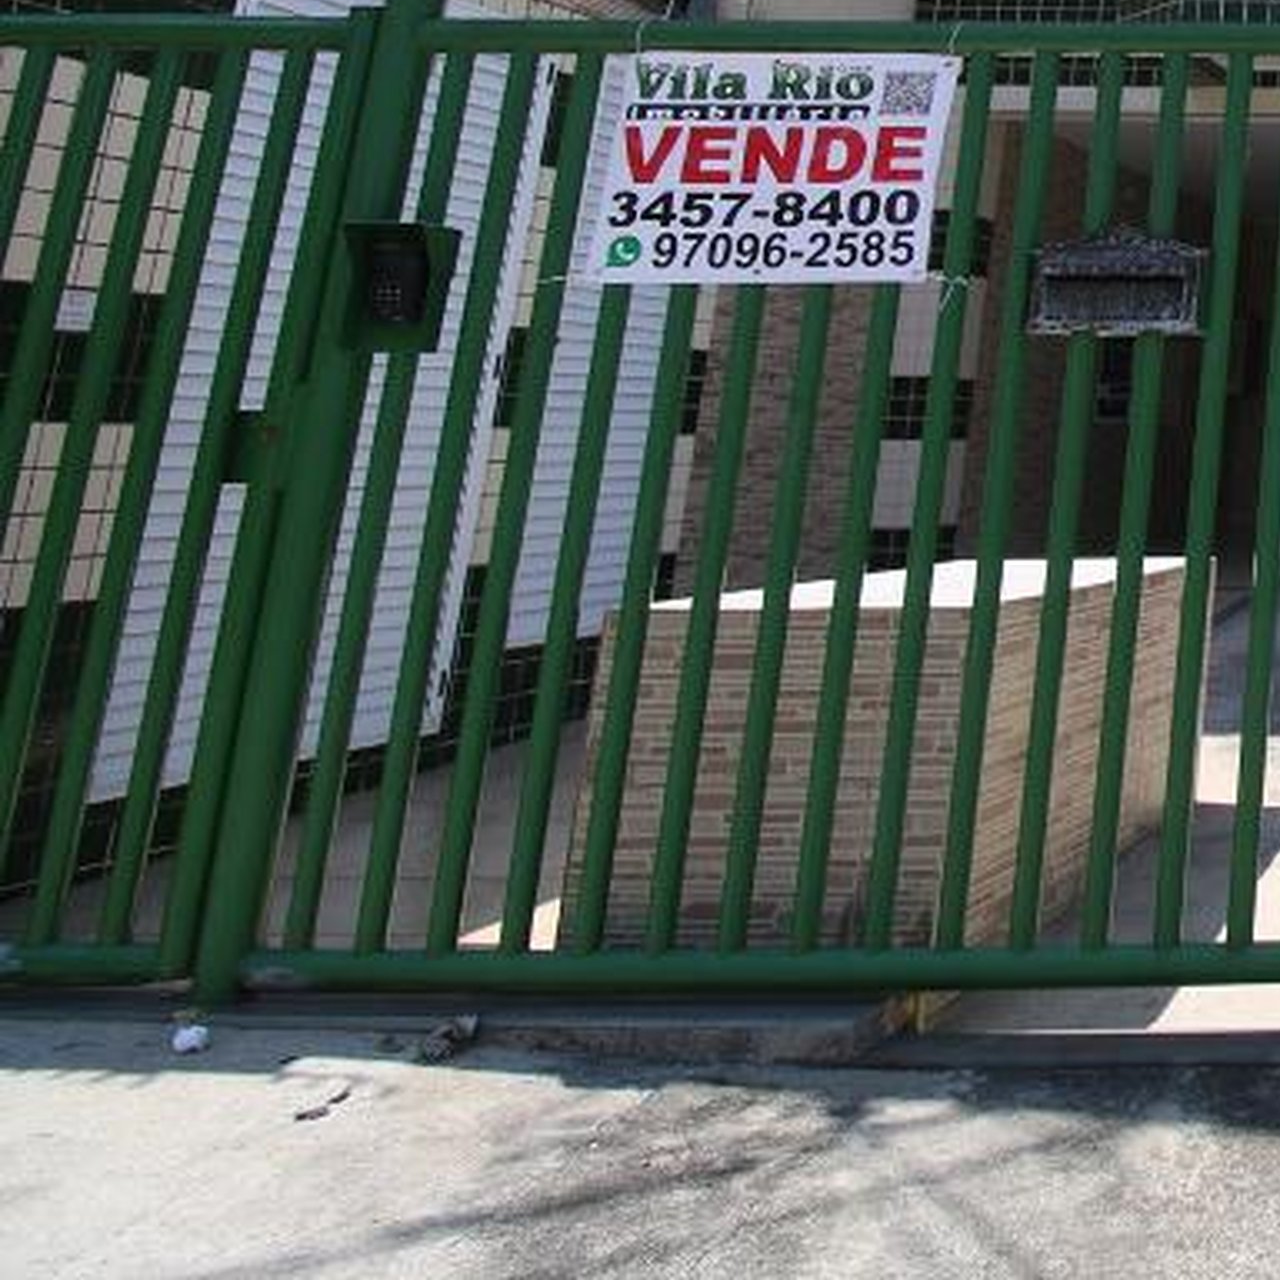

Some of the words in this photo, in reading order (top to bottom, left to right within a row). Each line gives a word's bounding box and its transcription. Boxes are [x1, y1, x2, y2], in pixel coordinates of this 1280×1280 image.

[635, 60, 748, 100] Vila
[767, 59, 875, 100] Rio
[625, 126, 928, 184] VENDE
[608, 190, 921, 227] 3457-8400
[652, 231, 915, 268] 97096-2585
